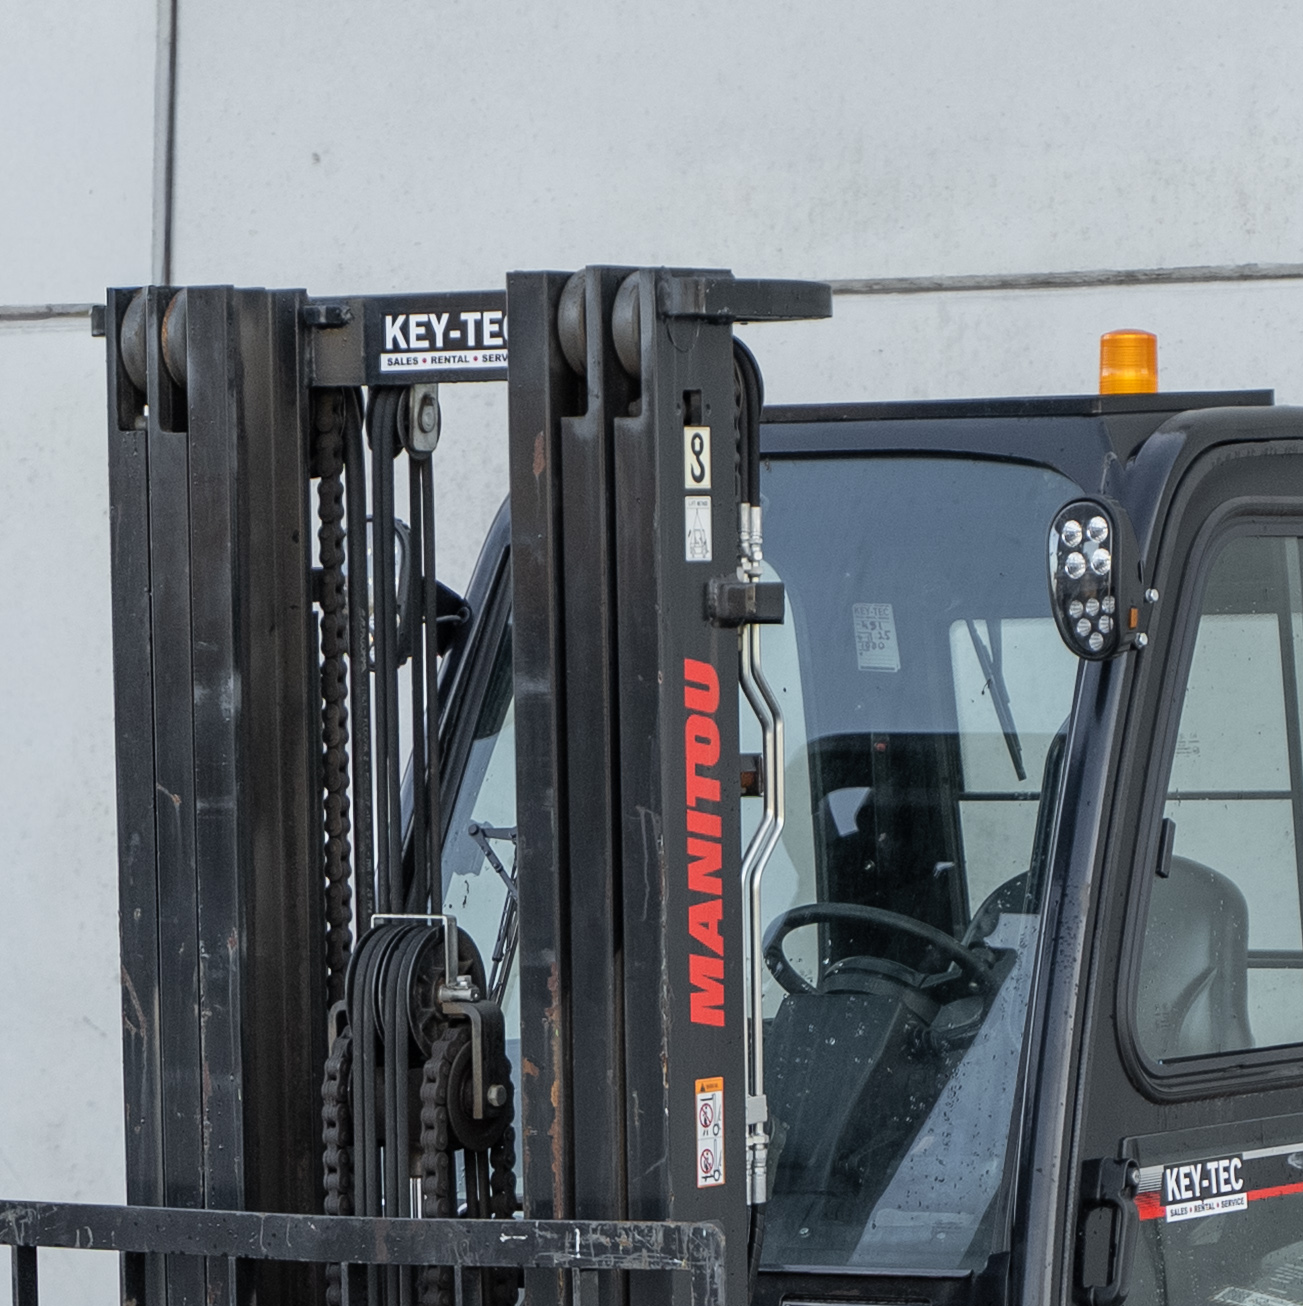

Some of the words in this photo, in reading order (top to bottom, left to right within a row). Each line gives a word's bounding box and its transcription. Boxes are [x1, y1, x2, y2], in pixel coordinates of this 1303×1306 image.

[384, 310, 508, 350] KEY-TE
[386, 356, 419, 366] SALES
[430, 354, 470, 365] RENTAL
[684, 658, 725, 1027] MANITOU
[1165, 1157, 1244, 1202] KEY-TEC
[1170, 1206, 1188, 1217] SALES
[1194, 1202, 1216, 1213] RENTAL
[1221, 1197, 1245, 1209] SERVICE
